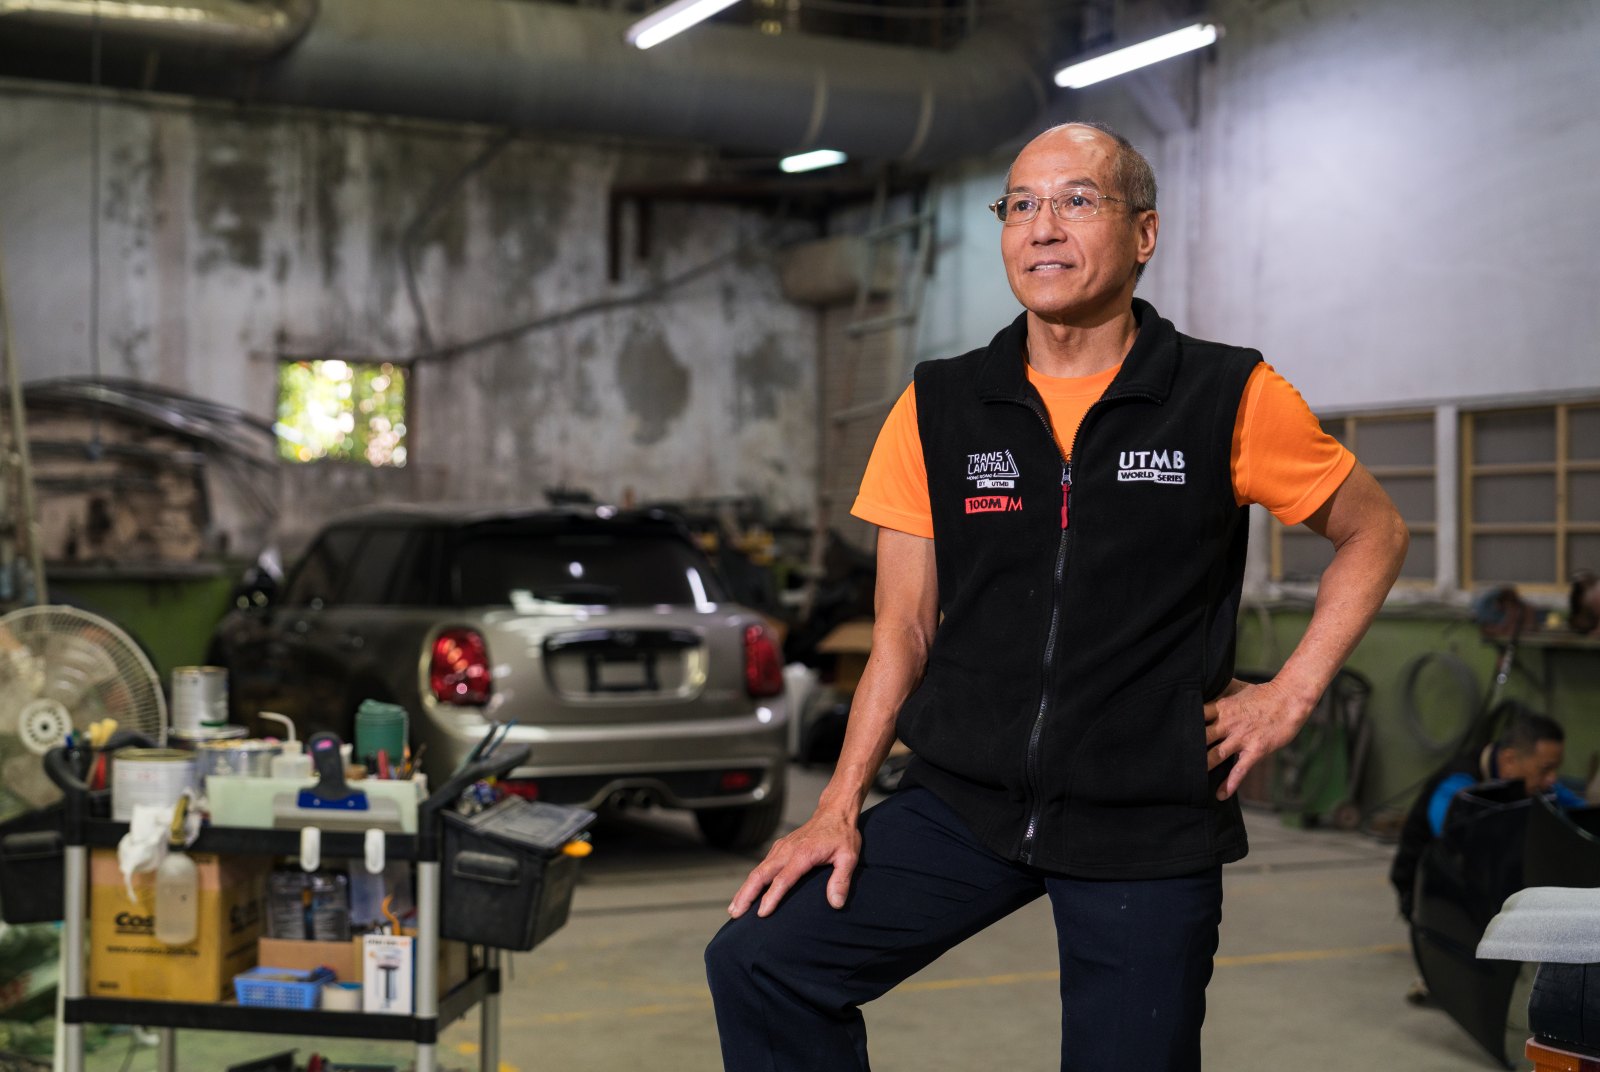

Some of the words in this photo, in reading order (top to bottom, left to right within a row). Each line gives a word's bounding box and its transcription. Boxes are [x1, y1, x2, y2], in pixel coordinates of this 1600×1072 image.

[967, 452, 1003, 464] TRANS
[1119, 449, 1185, 469] UTMB
[968, 461, 1009, 474] LANTAU
[1121, 471, 1154, 479] WORLD
[1157, 474, 1183, 482] SERIES
[969, 498, 1002, 511] 100M
